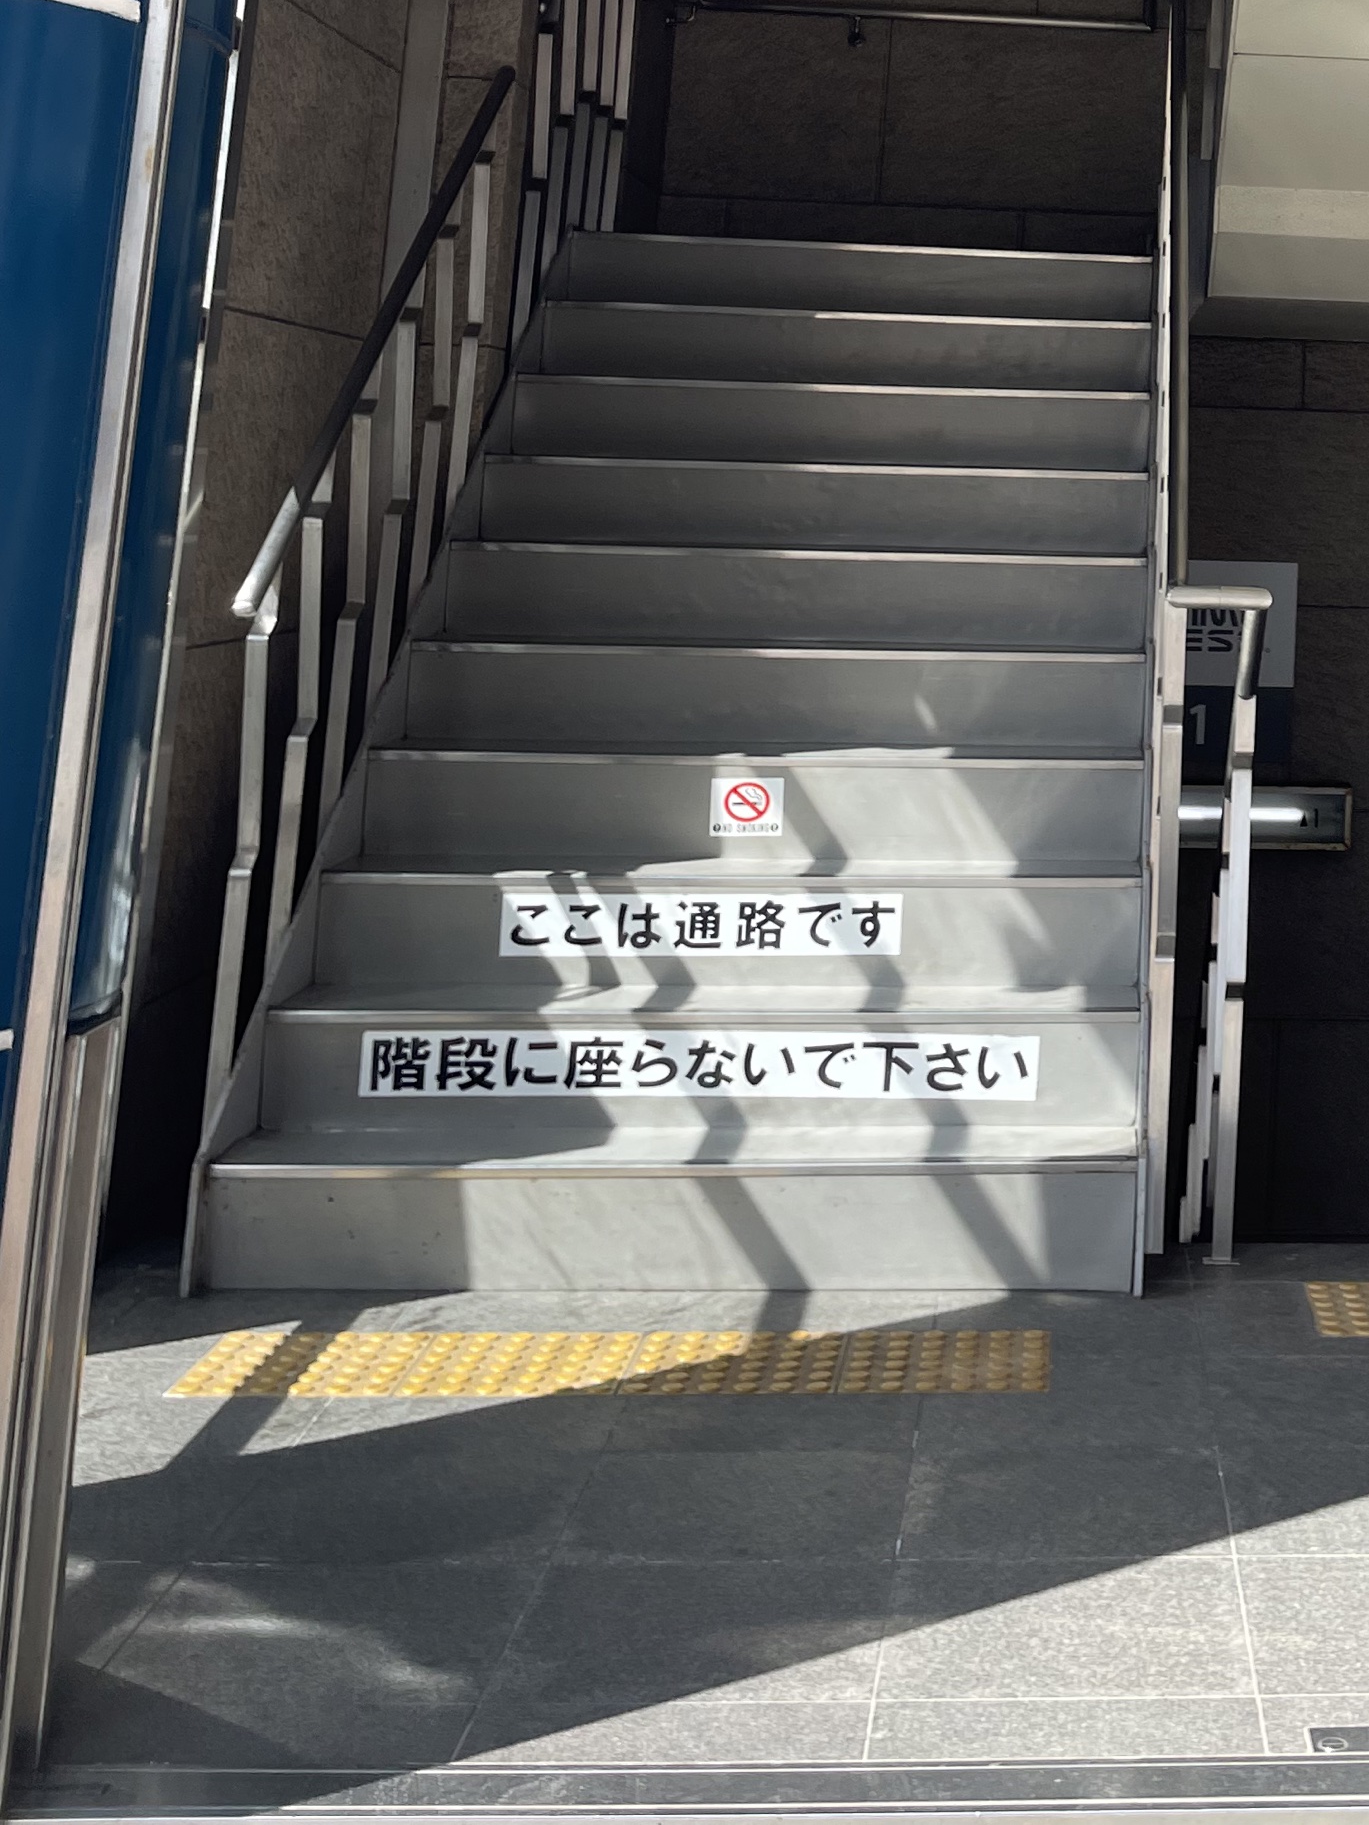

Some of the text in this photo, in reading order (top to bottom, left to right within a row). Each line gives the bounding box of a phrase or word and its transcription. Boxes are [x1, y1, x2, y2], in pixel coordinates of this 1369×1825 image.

[510, 901, 896, 949] ここは通路です
[370, 1036, 1029, 1092] 階段に座らないで下さい
